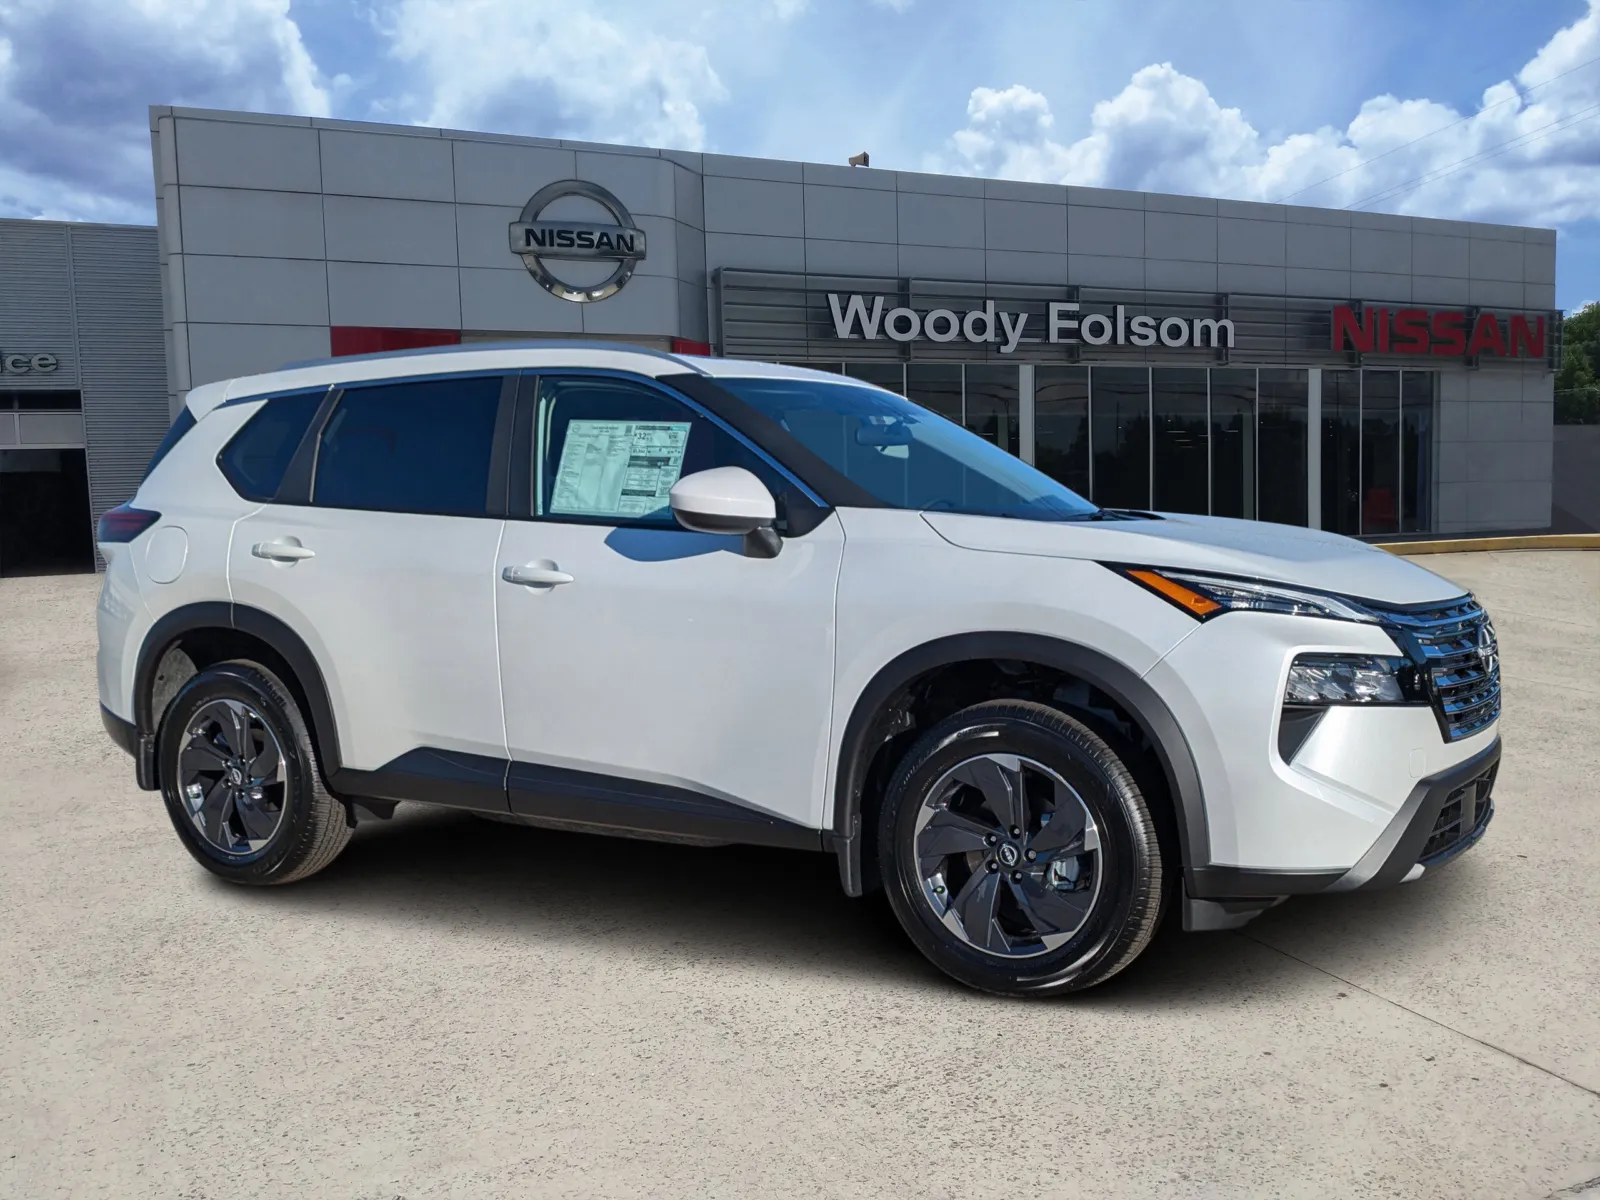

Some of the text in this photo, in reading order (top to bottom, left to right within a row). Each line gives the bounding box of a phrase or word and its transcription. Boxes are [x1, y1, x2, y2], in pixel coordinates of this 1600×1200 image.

[524, 228, 635, 253] NISSAN
[827, 293, 1235, 354] Woody Folsom
[1332, 305, 1545, 358] NISSAN
